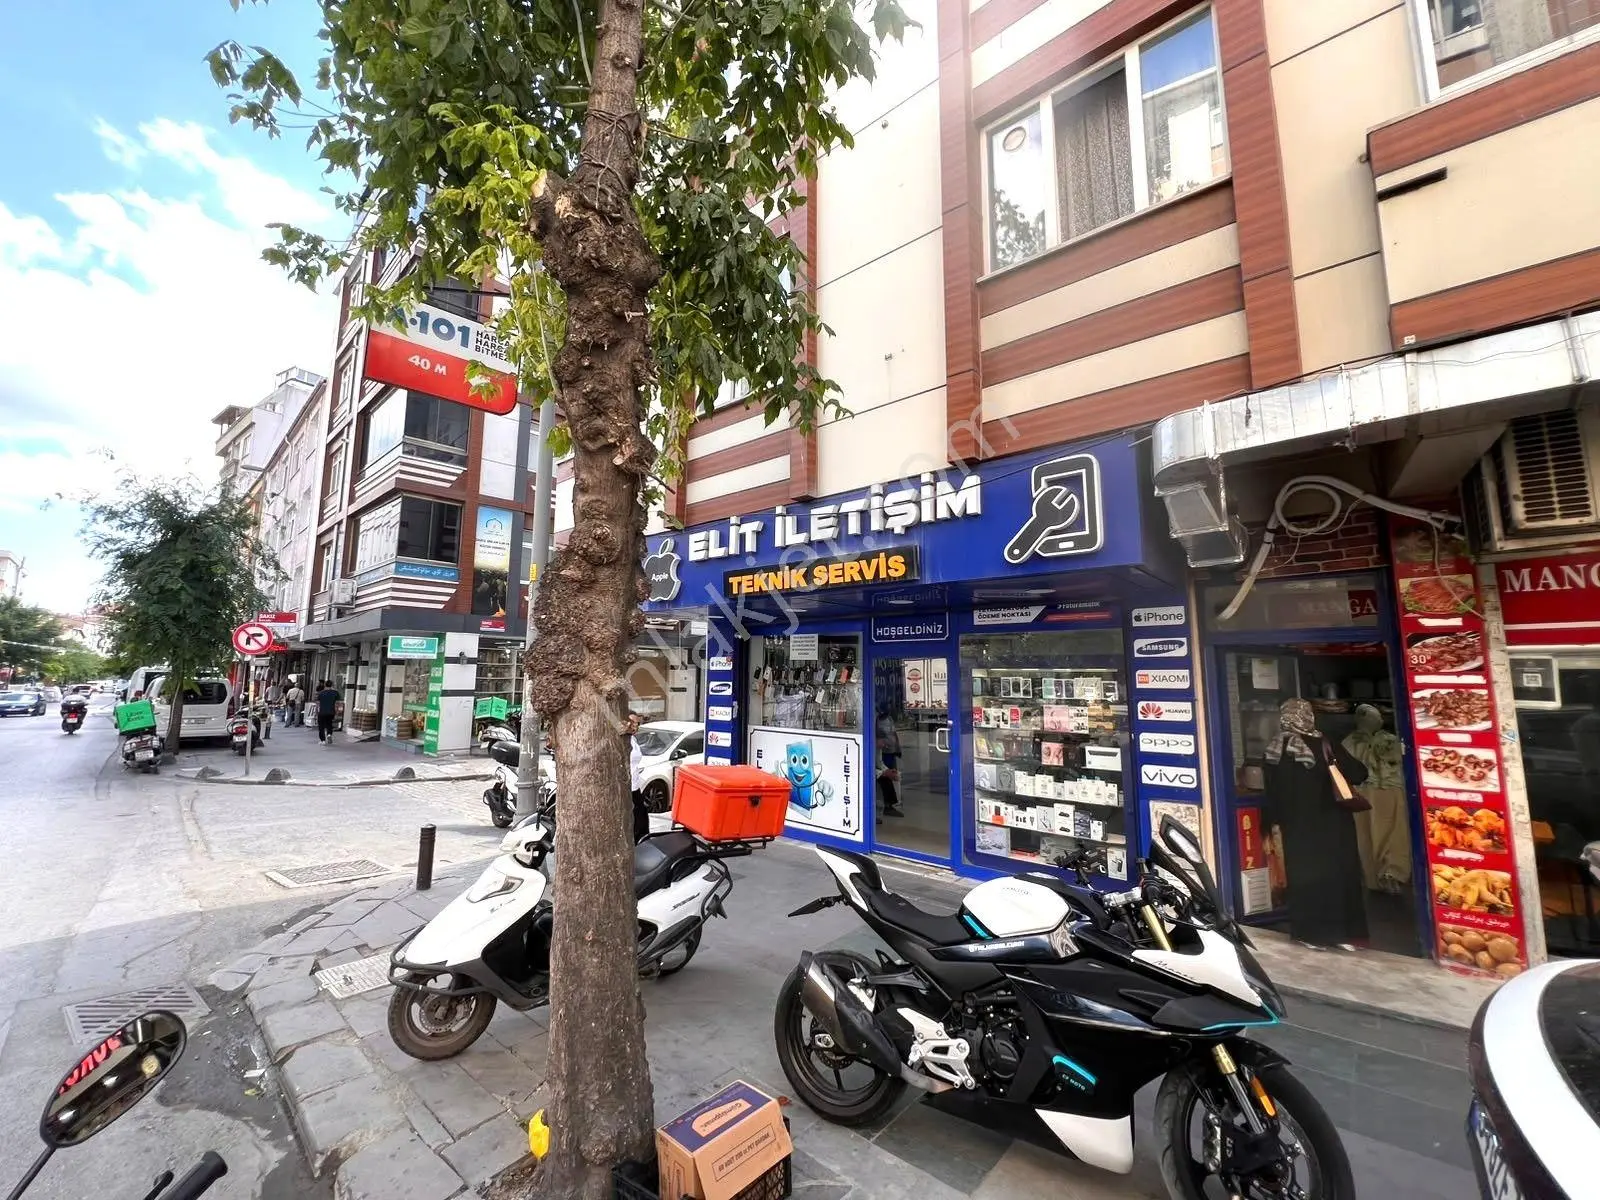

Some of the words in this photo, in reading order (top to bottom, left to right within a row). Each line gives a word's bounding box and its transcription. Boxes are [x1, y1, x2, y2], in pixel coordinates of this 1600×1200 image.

[408, 354, 431, 370] 40
[434, 364, 447, 376] M
[688, 515, 763, 562] ELİT
[774, 472, 982, 548] İLETİŞİM
[651, 572, 669, 582] Apple
[728, 567, 808, 596] TEKNİK
[813, 552, 907, 586] SERVİS
[1143, 612, 1183, 622] iPhone
[876, 622, 943, 639] HOŞGELDİNİZ
[1142, 643, 1179, 651] SAMSUNG
[1151, 674, 1188, 683] XIAOMI
[1143, 769, 1195, 785] vivo
